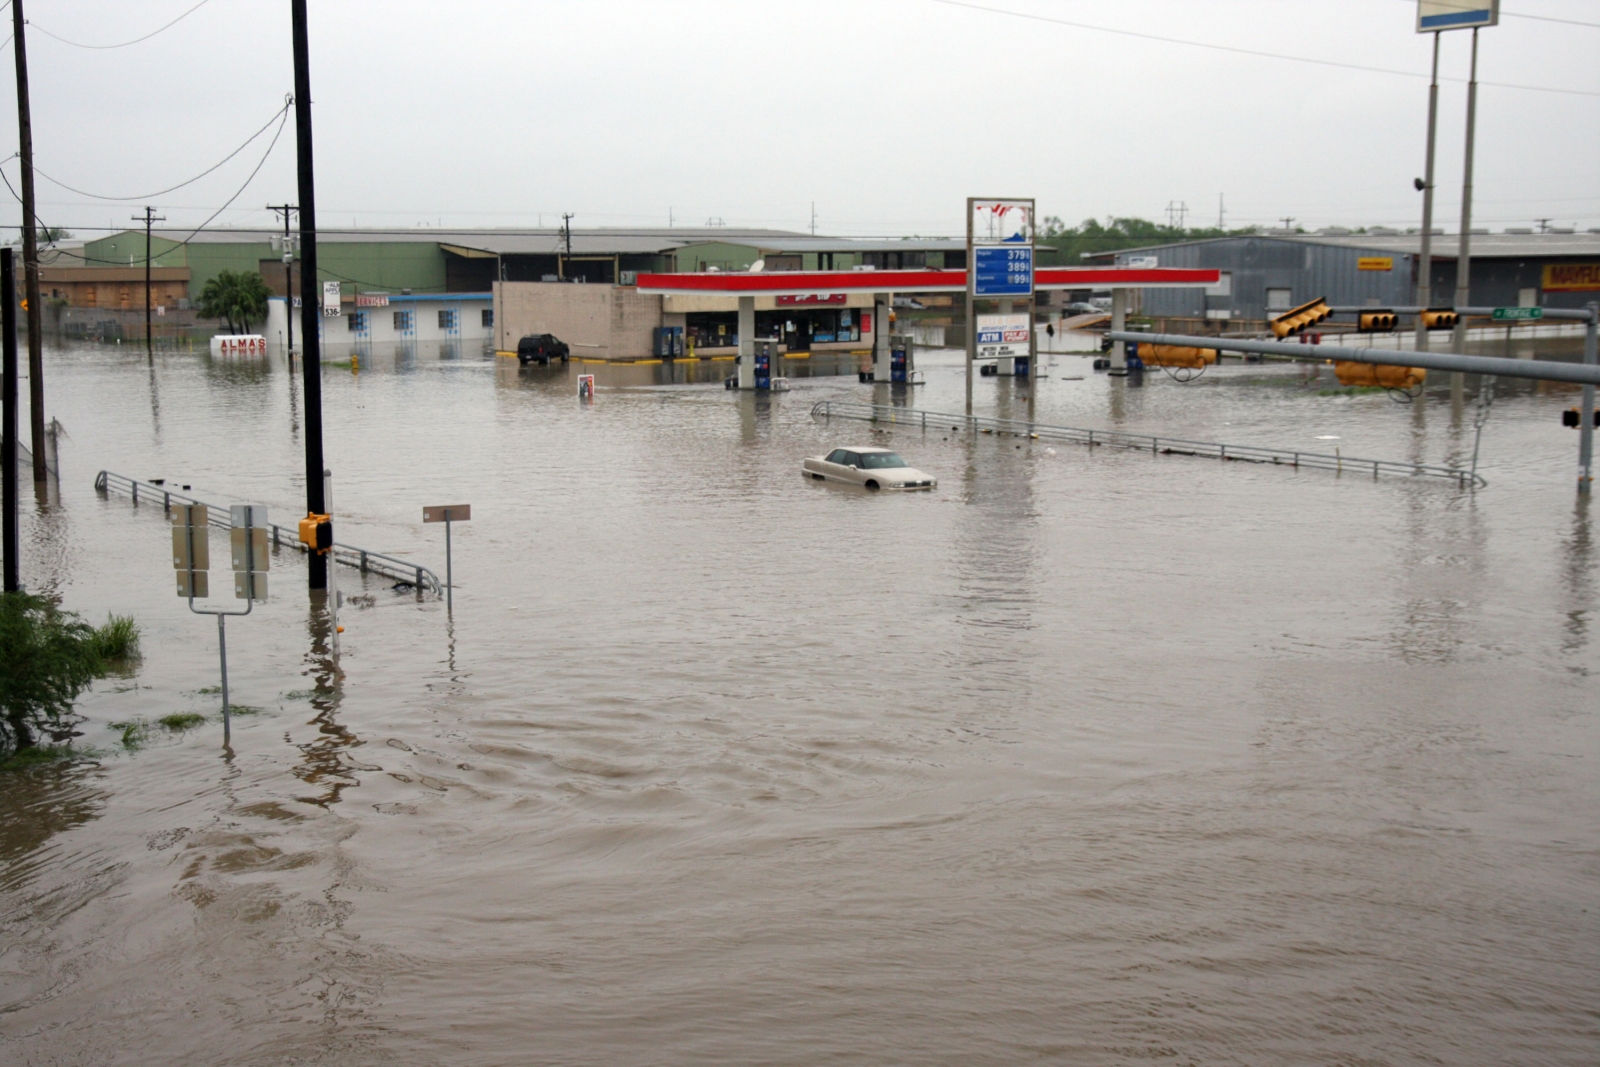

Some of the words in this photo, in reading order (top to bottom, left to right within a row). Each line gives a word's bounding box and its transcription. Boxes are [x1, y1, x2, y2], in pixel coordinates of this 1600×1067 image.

[1007, 250, 1025, 260] 379
[1007, 262, 1025, 272] 389
[356, 296, 388, 306] SERVICES
[981, 333, 1000, 342] ATM
